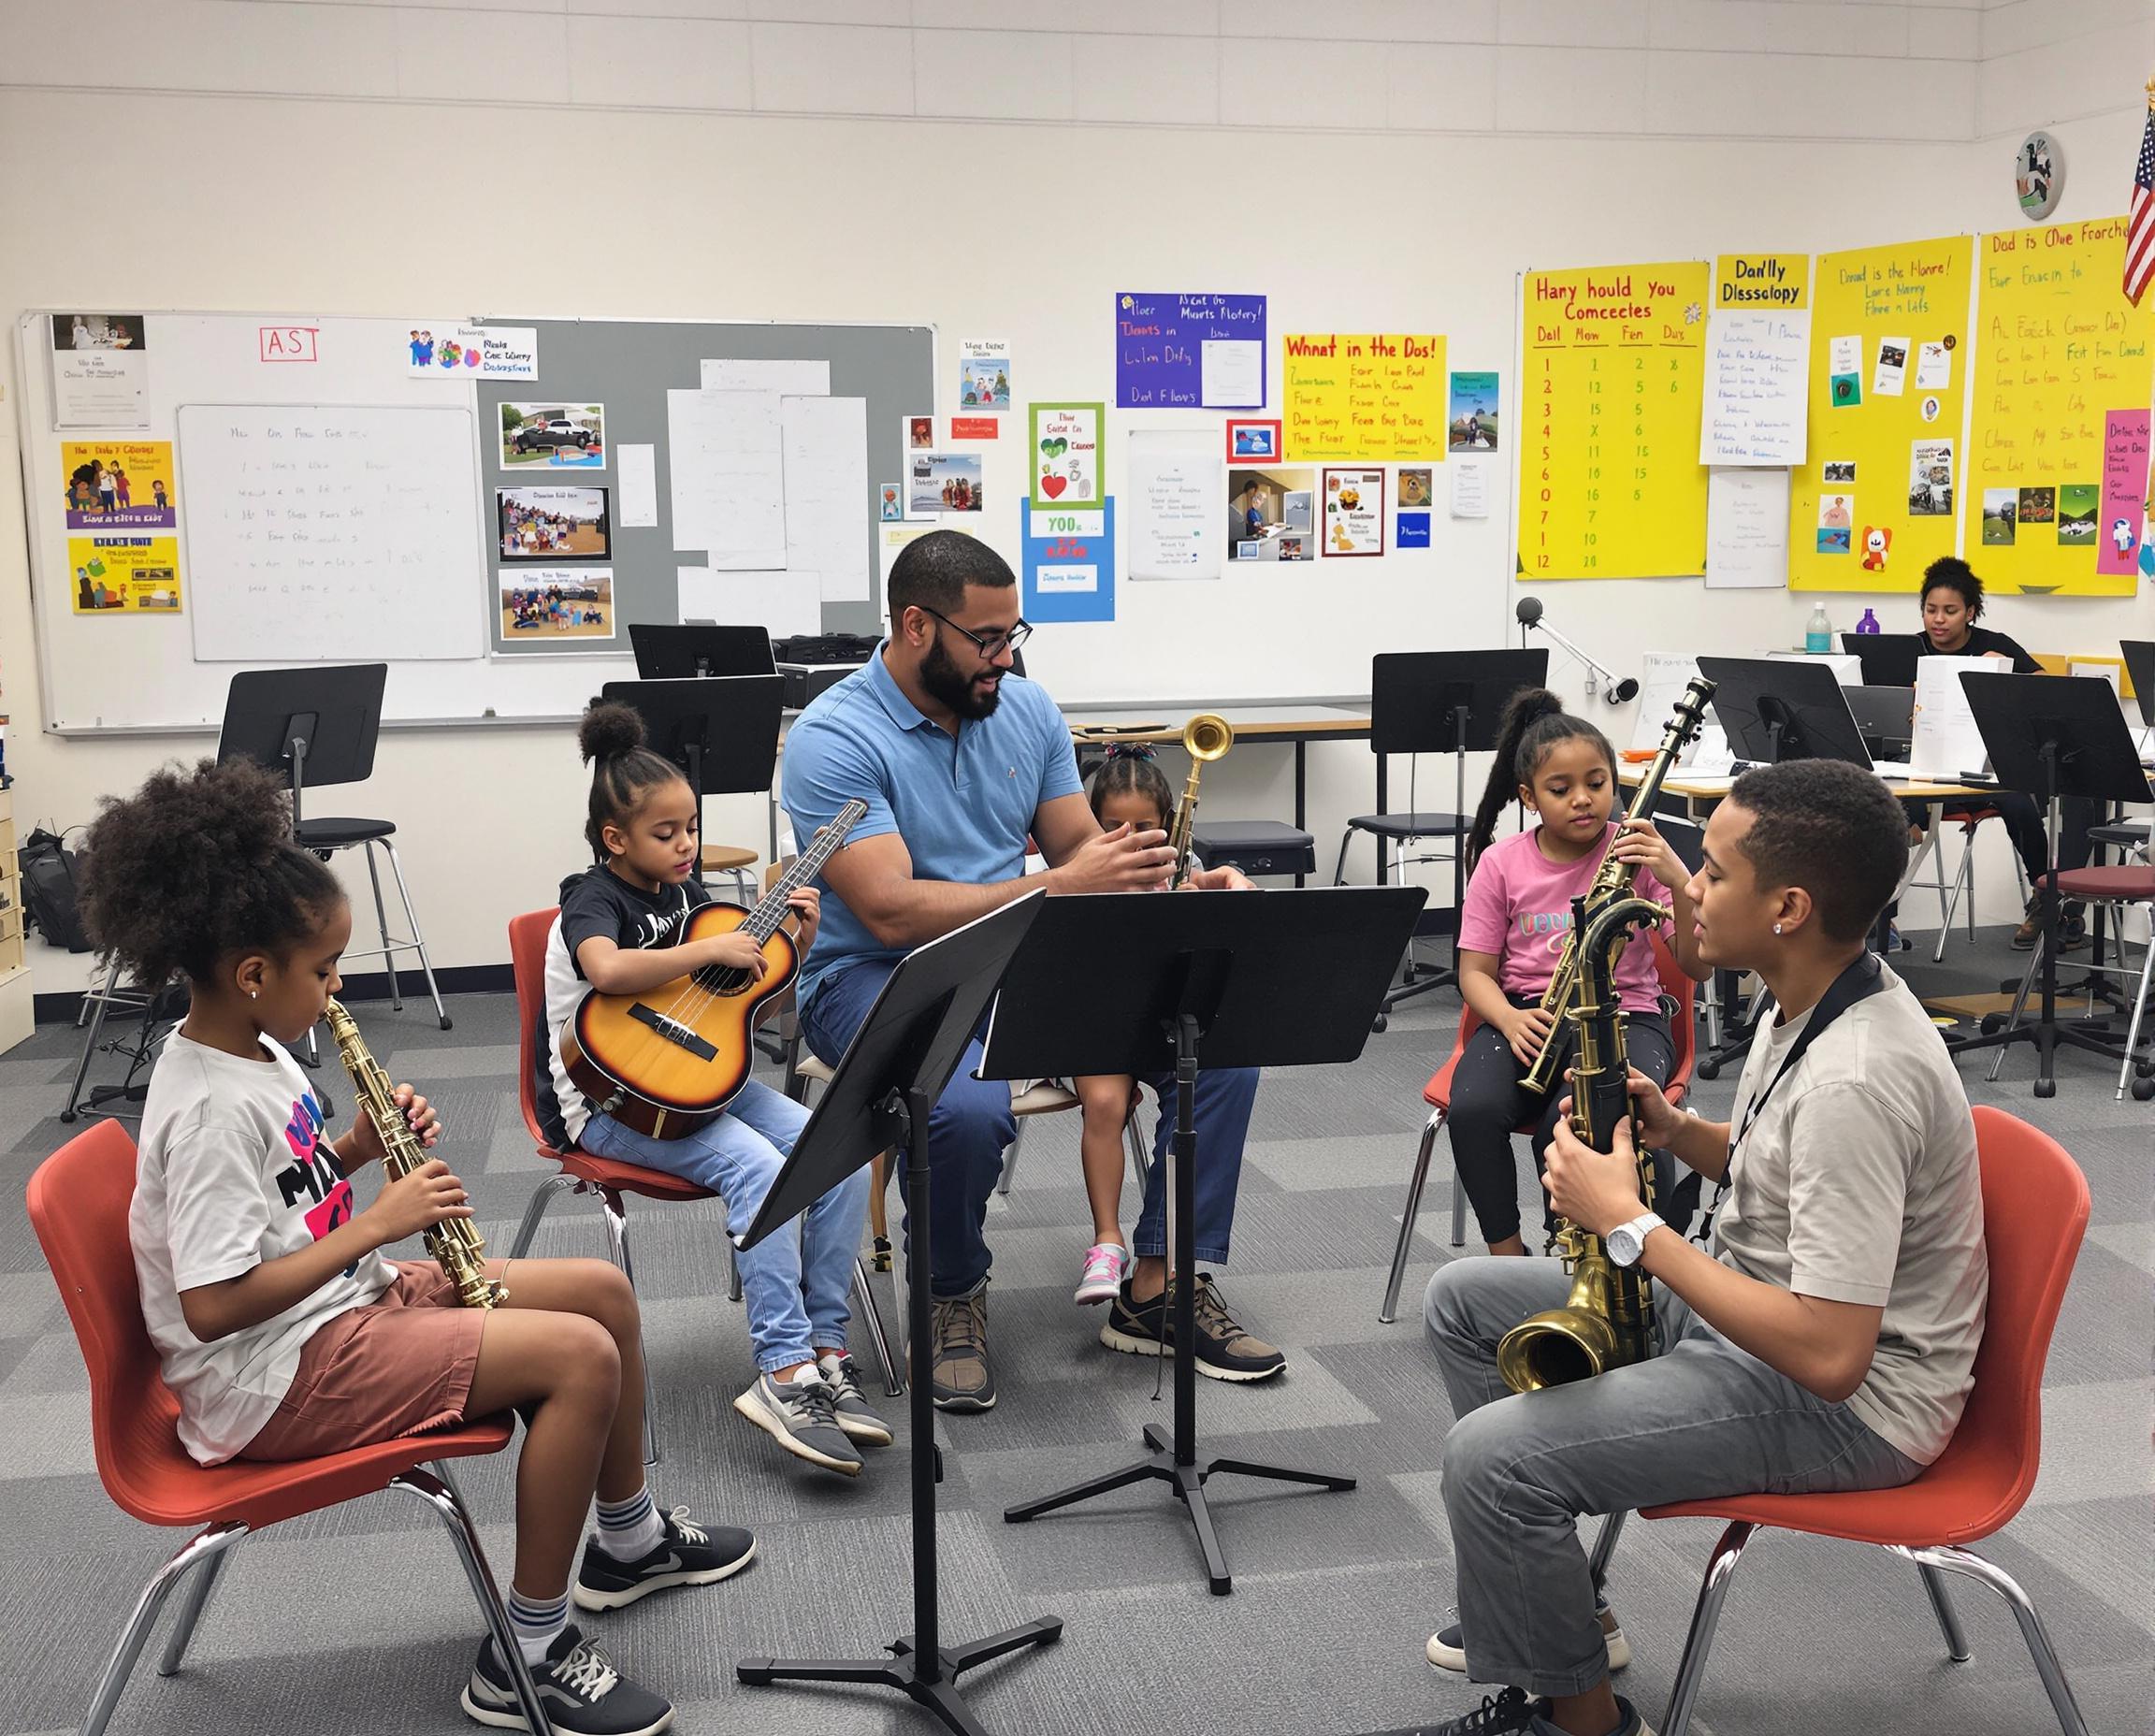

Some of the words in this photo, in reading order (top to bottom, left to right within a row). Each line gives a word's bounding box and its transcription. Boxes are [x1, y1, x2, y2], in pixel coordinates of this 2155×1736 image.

[1347, 340, 1362, 357] in
[1369, 335, 1396, 356] the
[1543, 379, 1552, 394] 2
[1543, 403, 1551, 417] 3
[1542, 425, 1550, 439] 4
[1542, 446, 1550, 460] 5
[1542, 468, 1550, 481] 6
[1540, 511, 1549, 525] 7
[1538, 555, 1550, 568] 12
